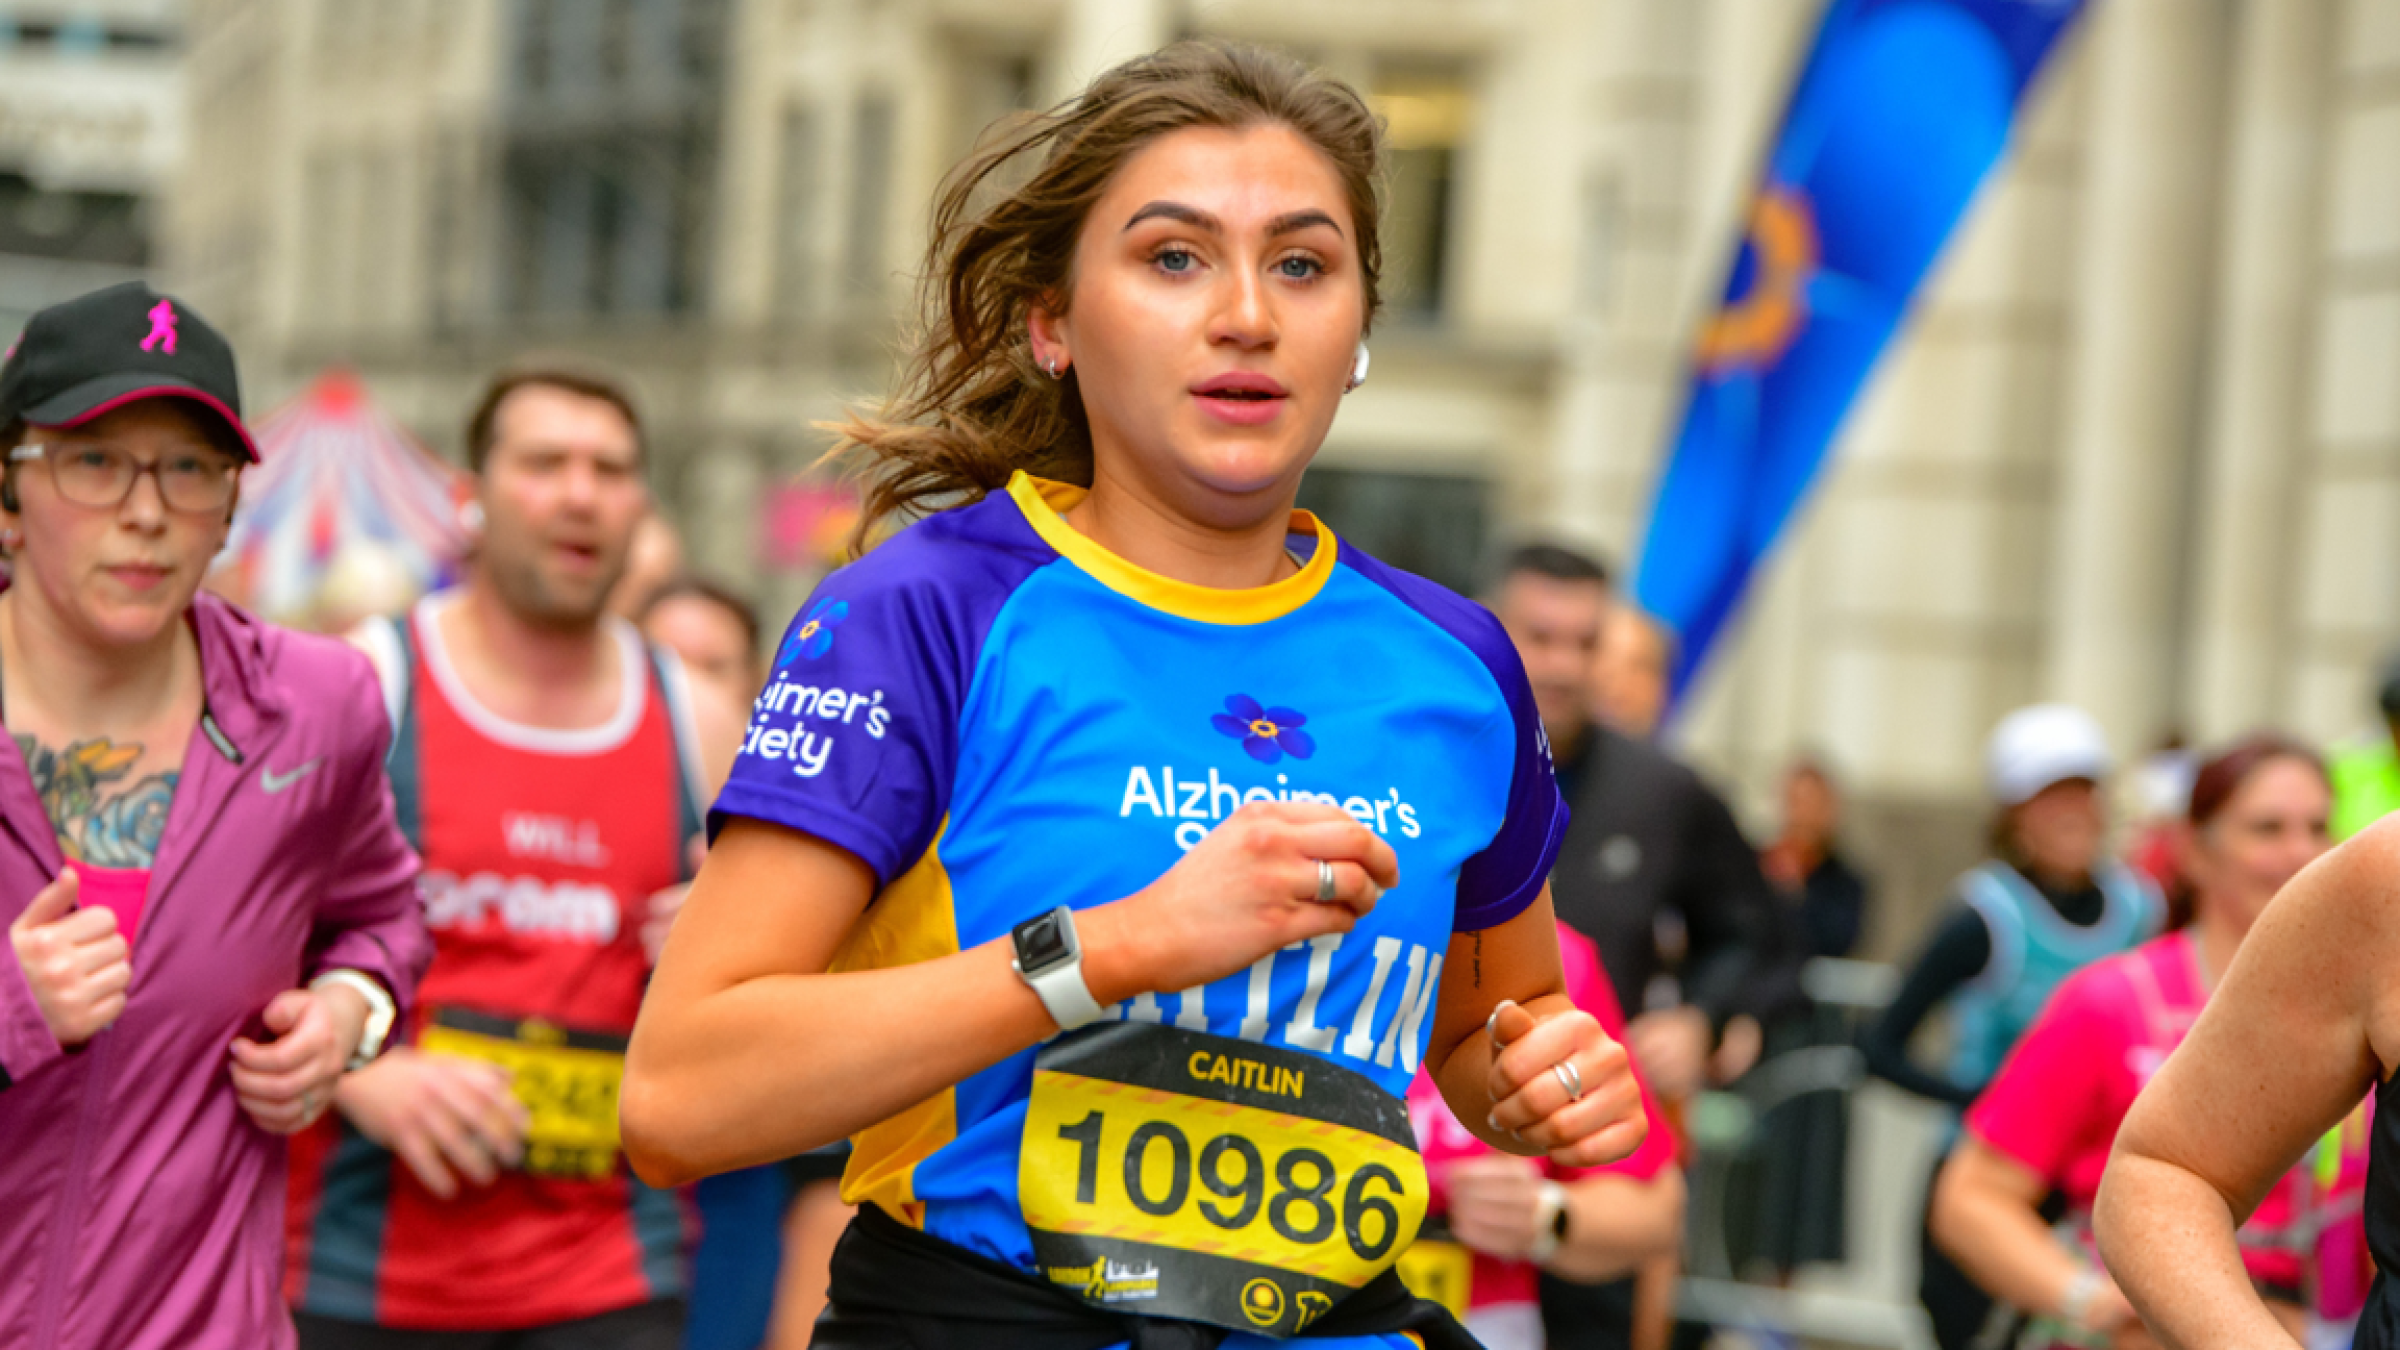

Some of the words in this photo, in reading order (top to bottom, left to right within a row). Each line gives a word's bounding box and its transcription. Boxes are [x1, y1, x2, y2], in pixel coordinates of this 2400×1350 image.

[504, 815, 610, 867] WILL
[1102, 932, 1443, 1076] TLIN
[1187, 1050, 1304, 1099] CAITLIN
[1057, 1109, 1404, 1262] 10986
